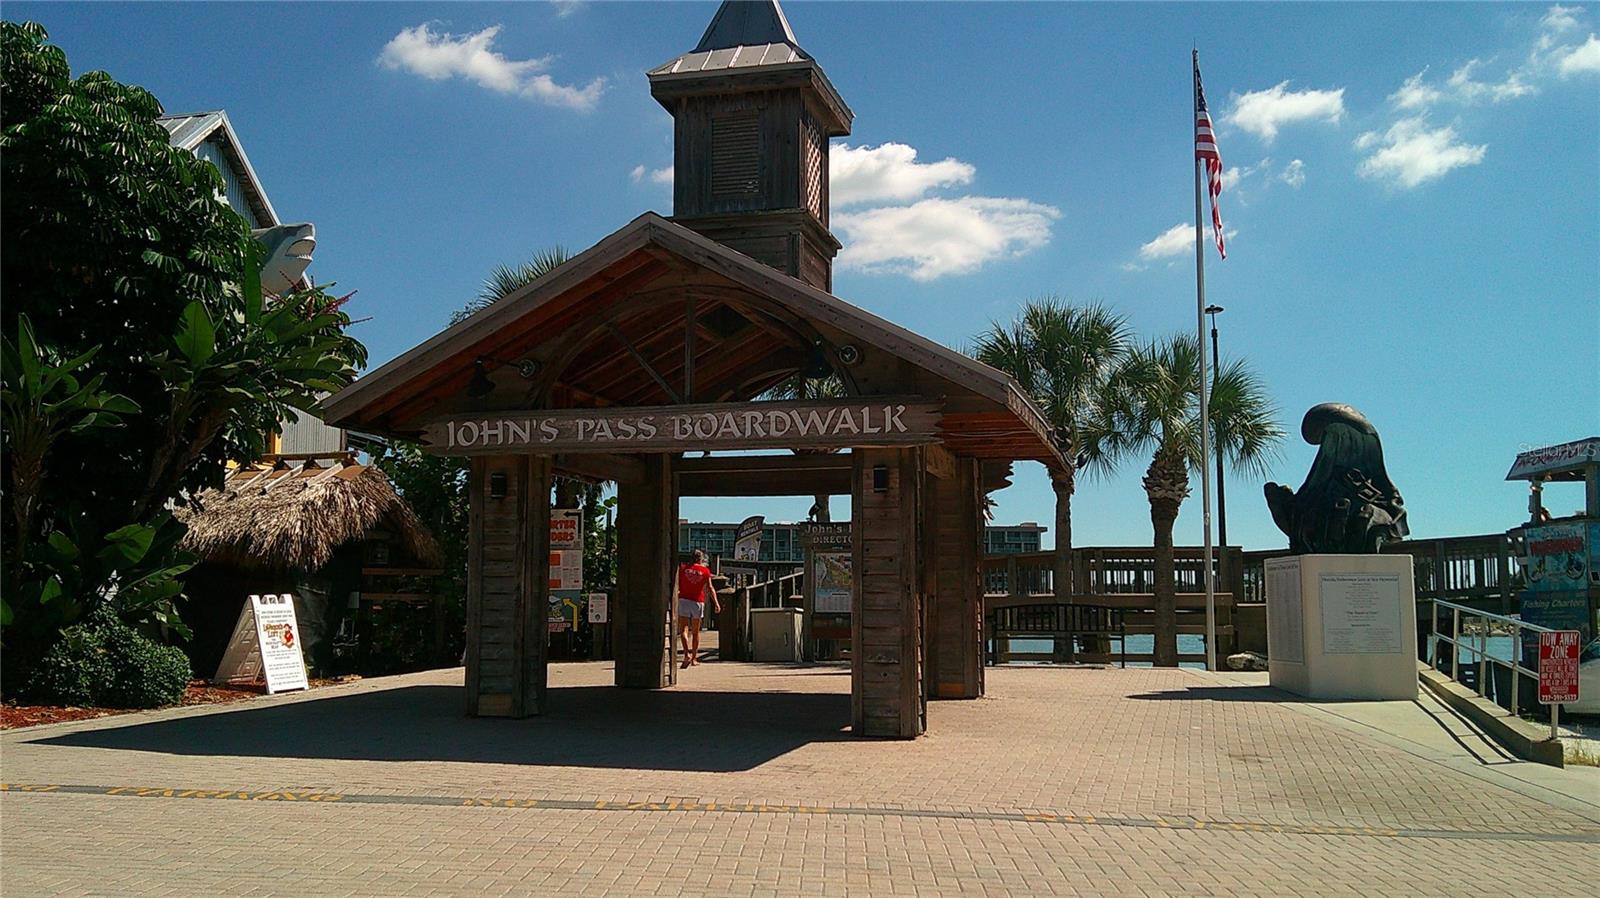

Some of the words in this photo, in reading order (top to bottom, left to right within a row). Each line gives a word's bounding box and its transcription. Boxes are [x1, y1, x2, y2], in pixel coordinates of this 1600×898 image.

[446, 417, 560, 450] JOHN'S
[576, 413, 659, 442] PASS
[670, 404, 909, 440] BOARDWALK
[805, 524, 843, 533] John's
[1542, 632, 1557, 646] TOW
[1559, 632, 1578, 646] AWAY
[1550, 645, 1569, 659] ZONE
